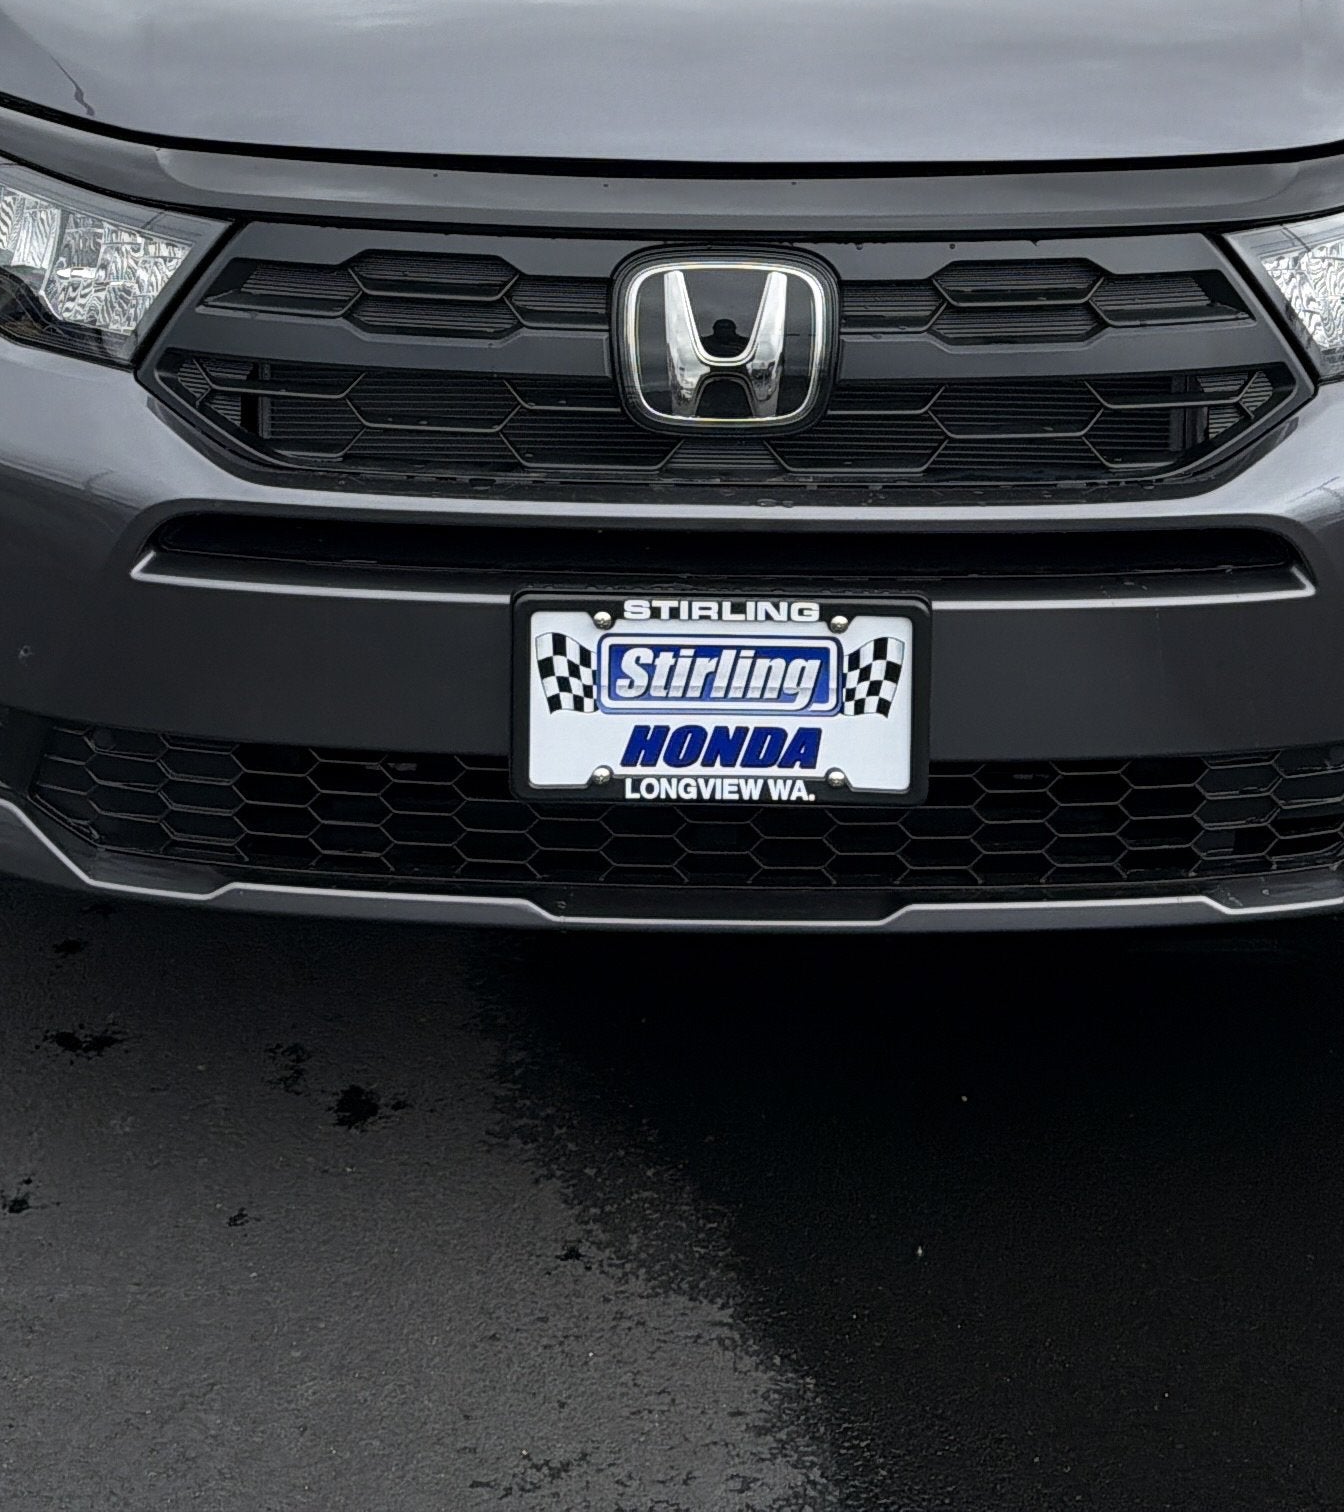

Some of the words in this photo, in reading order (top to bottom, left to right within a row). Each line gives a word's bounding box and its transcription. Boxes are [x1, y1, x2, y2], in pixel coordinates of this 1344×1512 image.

[623, 599, 820, 622] STIRLING
[614, 647, 822, 711] Stirling
[620, 724, 822, 769] HONDA
[624, 777, 764, 801] LONGVIEW
[766, 777, 816, 801] WA.
